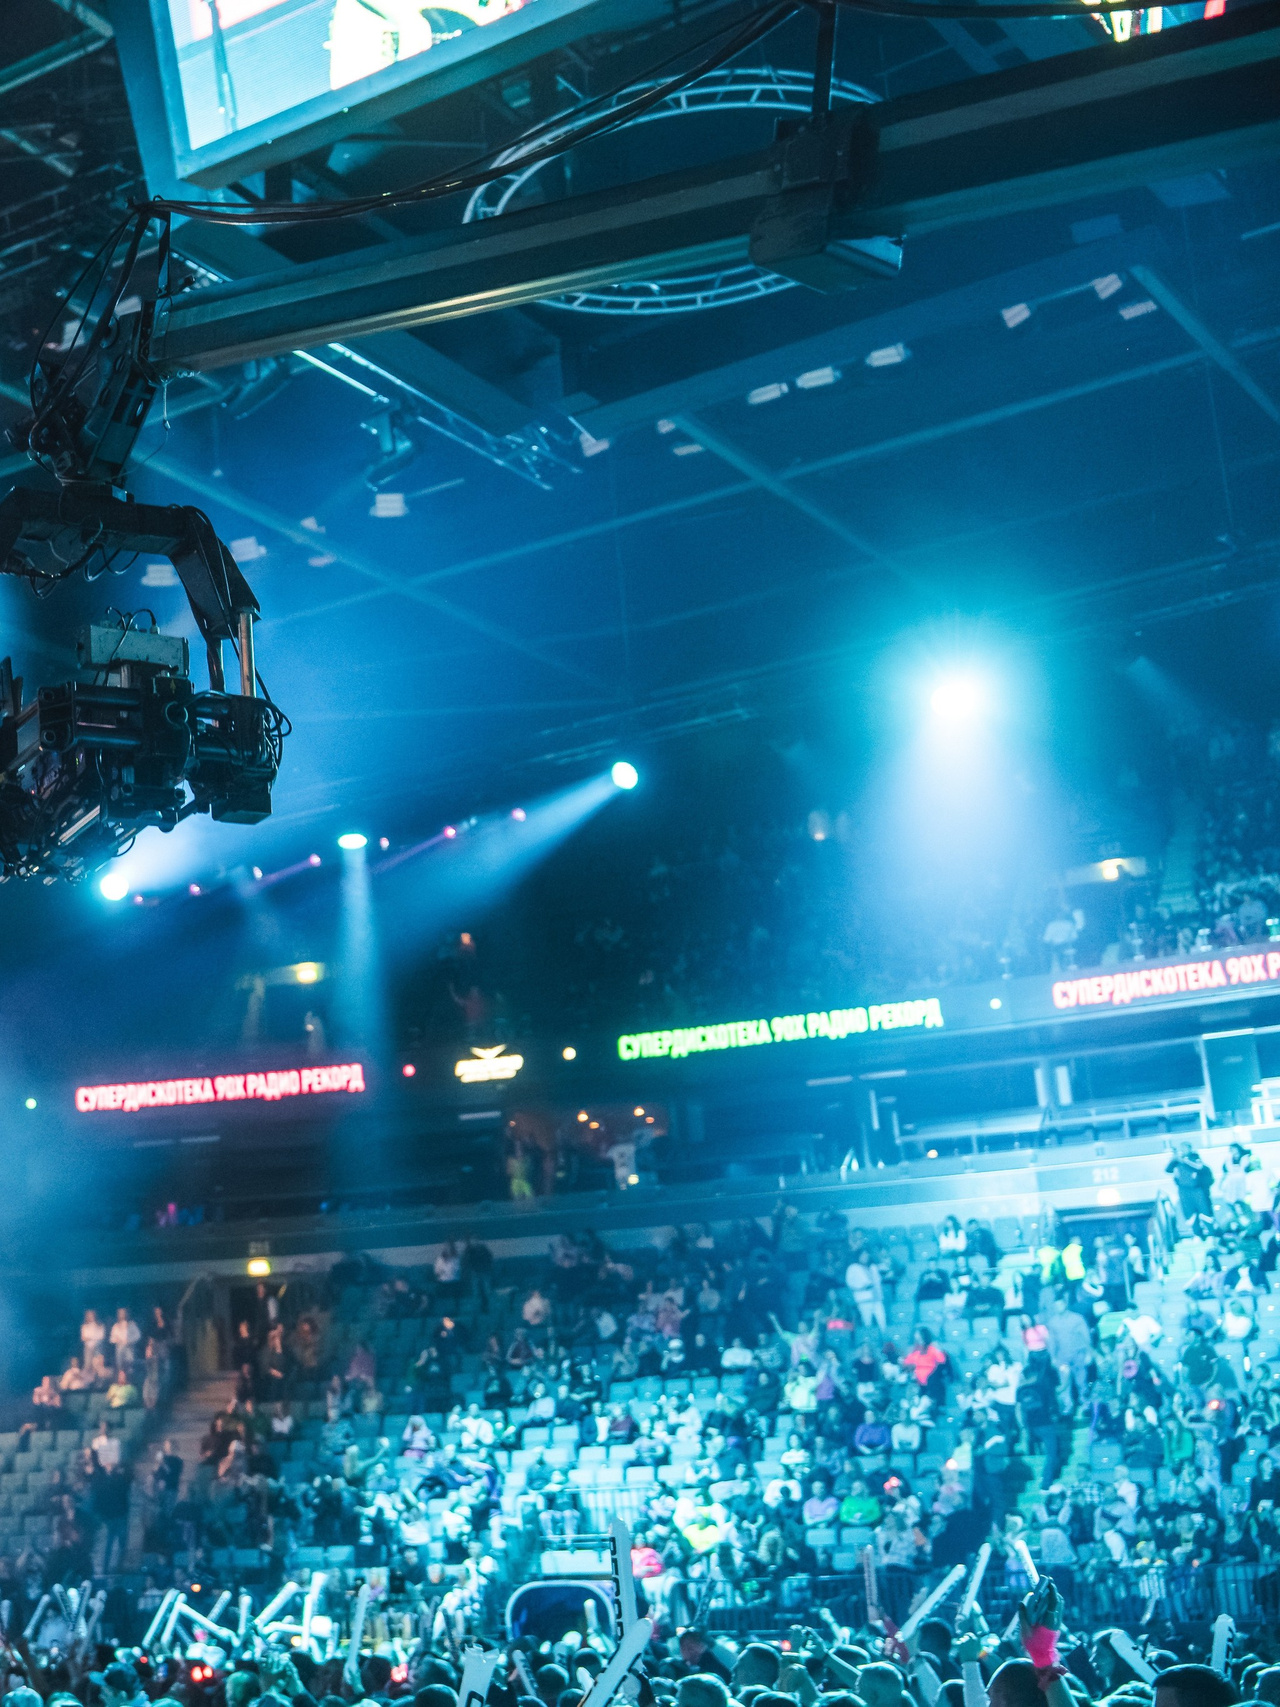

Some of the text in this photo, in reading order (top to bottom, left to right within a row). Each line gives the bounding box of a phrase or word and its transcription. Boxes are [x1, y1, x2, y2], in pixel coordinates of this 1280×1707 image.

[1052, 960, 1227, 1009] СУПЕРДИСКОТЕКА
[618, 1019, 772, 1061] СУПЕРДИСКОТЕКА
[806, 1007, 869, 1040] РАДИО
[868, 998, 944, 1031] РЕКОРД
[75, 1077, 215, 1112] СУПЕРДИСКОТЕКА
[246, 1069, 300, 1101] РАДИО
[300, 1063, 366, 1094] РЕКОРД
